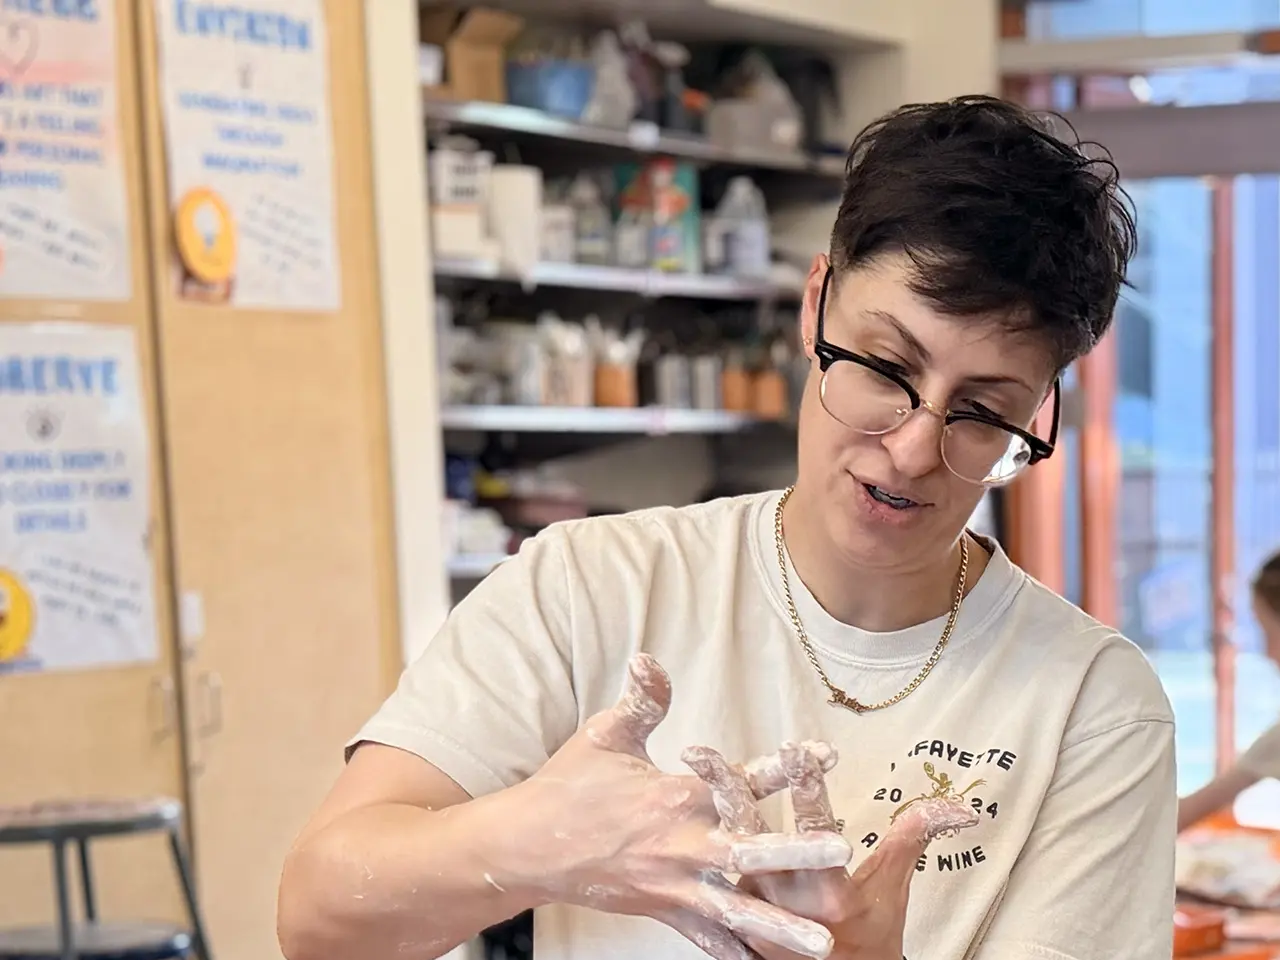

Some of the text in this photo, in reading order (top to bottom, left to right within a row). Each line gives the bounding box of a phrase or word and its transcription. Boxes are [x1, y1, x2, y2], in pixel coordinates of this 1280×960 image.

[889, 740, 1017, 772] FAYETE
[873, 787, 999, 819] 20 24
[936, 845, 987, 872] WINE
